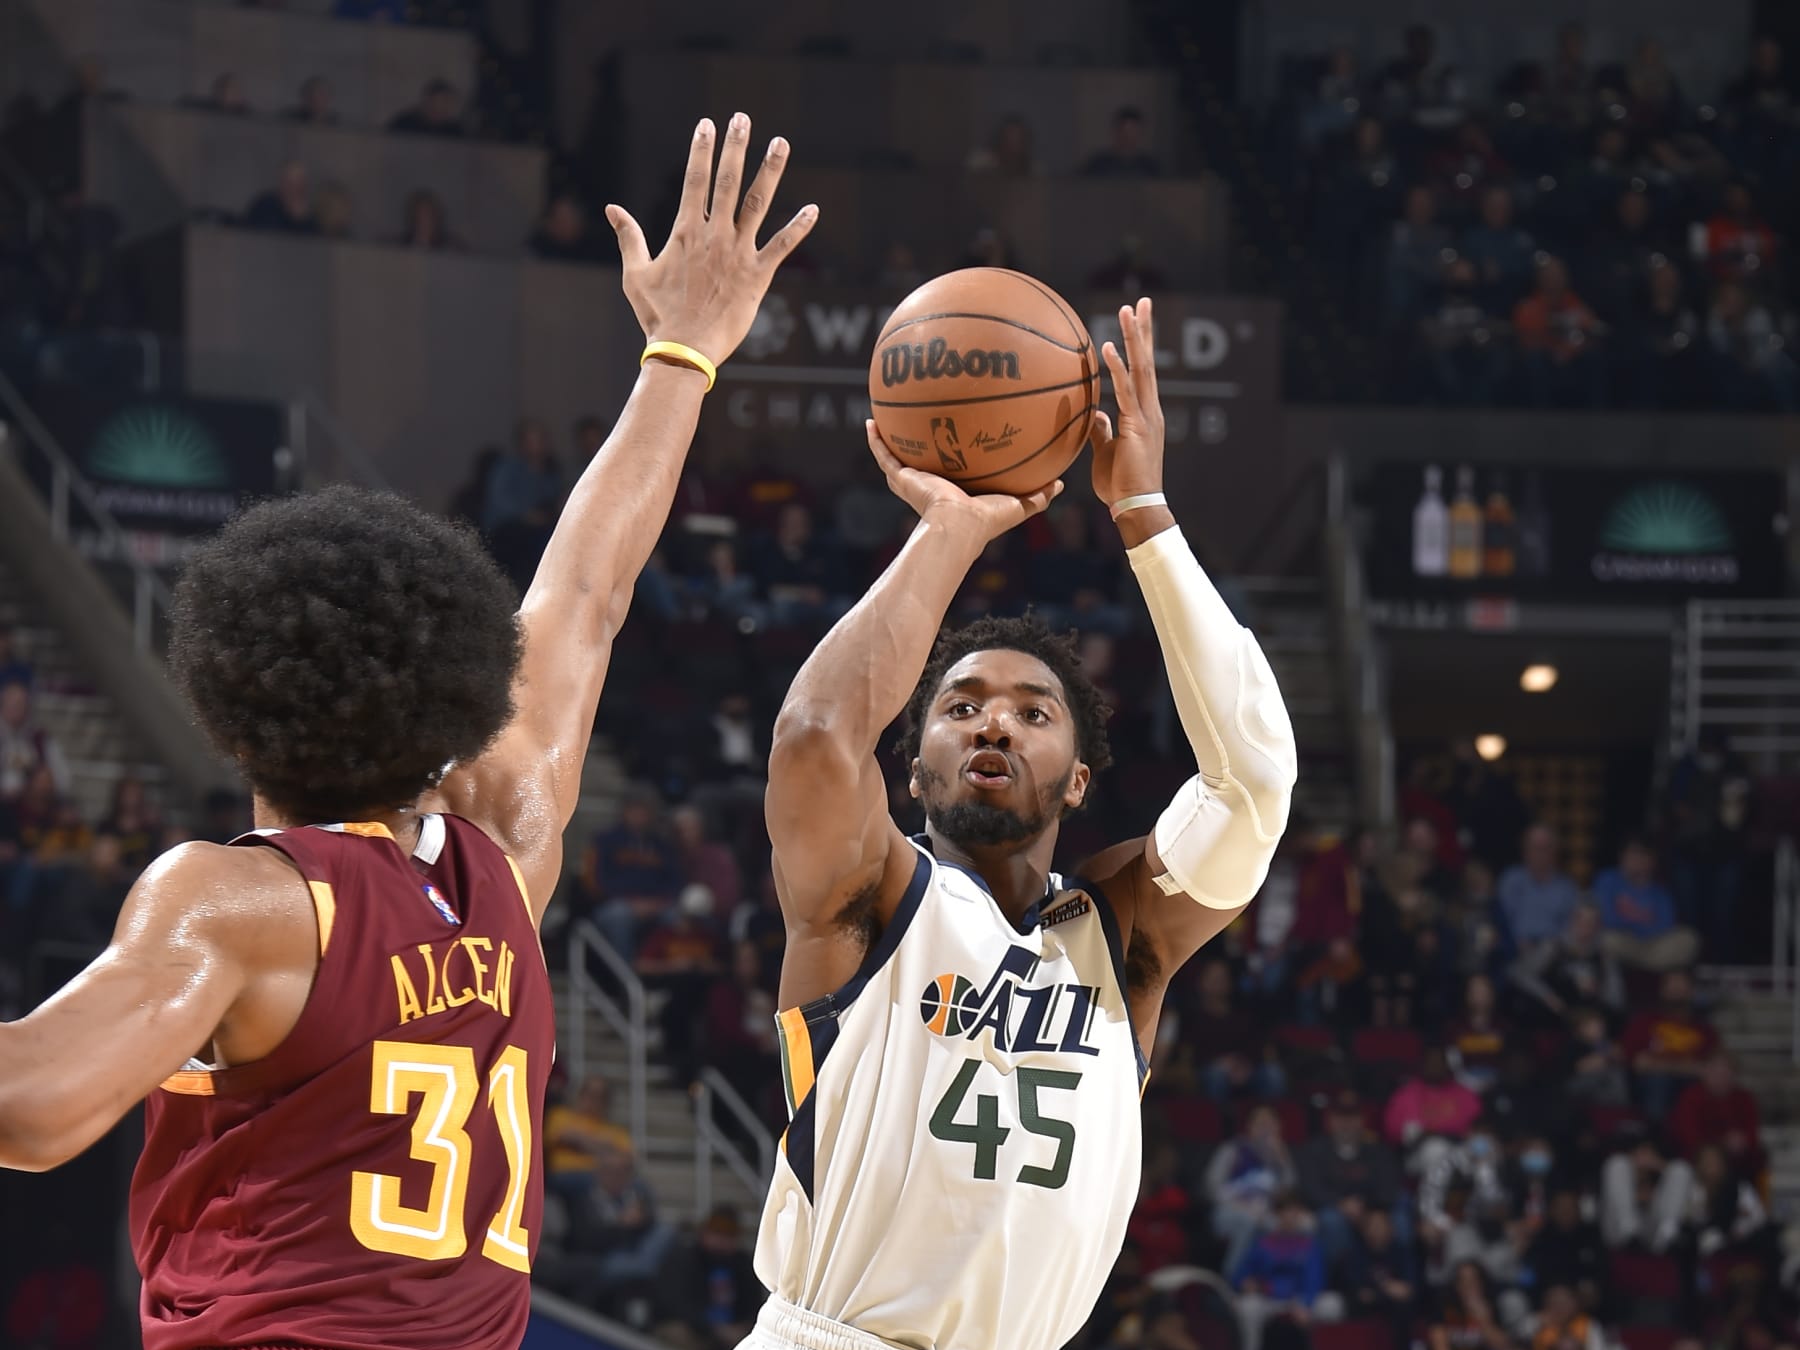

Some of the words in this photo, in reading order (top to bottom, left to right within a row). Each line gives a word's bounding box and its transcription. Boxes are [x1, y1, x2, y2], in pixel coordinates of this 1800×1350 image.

[881, 337, 1022, 388] Wilson
[349, 1040, 533, 1274] 31
[929, 1058, 1083, 1190] 45
